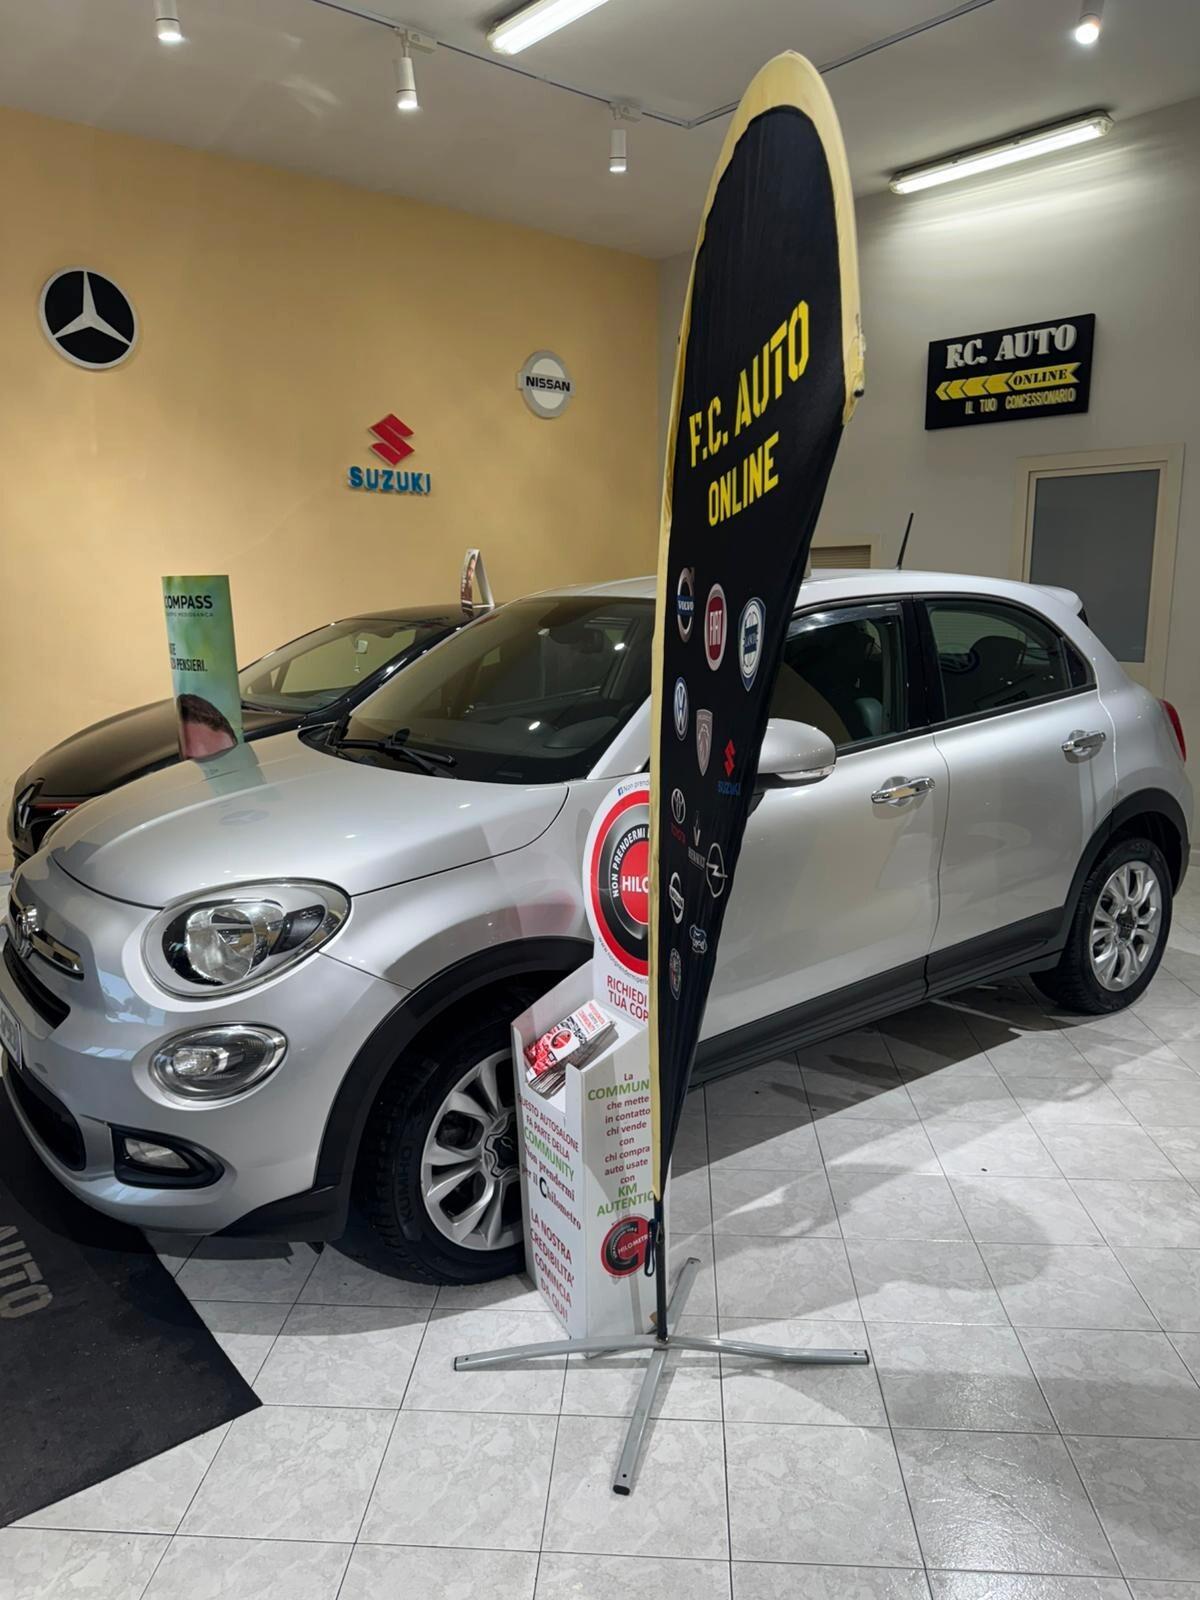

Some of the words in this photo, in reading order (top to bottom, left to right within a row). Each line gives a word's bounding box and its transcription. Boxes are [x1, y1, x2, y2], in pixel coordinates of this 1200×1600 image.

[945, 338, 988, 369] F.C.
[994, 324, 1077, 361] AUTO
[526, 375, 571, 392] NISSAN
[689, 396, 729, 468] F.C.
[735, 300, 809, 438] AUTO
[1013, 369, 1068, 386] ONLINE
[964, 400, 974, 415] IL
[979, 397, 998, 413] TUO
[1005, 387, 1077, 409] CONCESSIONARIO
[349, 466, 432, 494] SUZUKI
[708, 431, 779, 527] ONLINE
[708, 609, 722, 646] FIAT
[612, 827, 646, 871] PRENDERMI
[607, 975, 647, 1007] RICHIEDI
[608, 990, 627, 1012] TUA
[588, 1080, 650, 1101] COMMUN
[624, 1073, 634, 1081] La
[605, 1115, 614, 1124] in
[615, 1108, 651, 1122] contatto
[607, 1101, 622, 1111] che
[624, 1096, 650, 1107] mette
[526, 1114, 533, 1127] FA
[533, 1121, 551, 1144] PARTE
[552, 1137, 570, 1160] DELLA
[540, 1112, 579, 1153] AUTOSALONE
[606, 1127, 619, 1137] chi
[621, 1121, 647, 1133] vende
[619, 1137, 635, 1147] con
[524, 1126, 574, 1181] COMMUNITY
[605, 1153, 618, 1163] chi
[620, 1146, 650, 1160] compra
[605, 1166, 624, 1176] auto
[626, 1159, 648, 1170] usate
[539, 1160, 575, 1202] prendermi
[618, 1183, 637, 1197] KM
[620, 1175, 635, 1184] con
[539, 1176, 581, 1230] Chilometro
[531, 1208, 540, 1228] LA
[541, 1219, 572, 1264] NOSTRA
[535, 1253, 572, 1307] COMINCIA
[541, 1278, 550, 1299] DA
